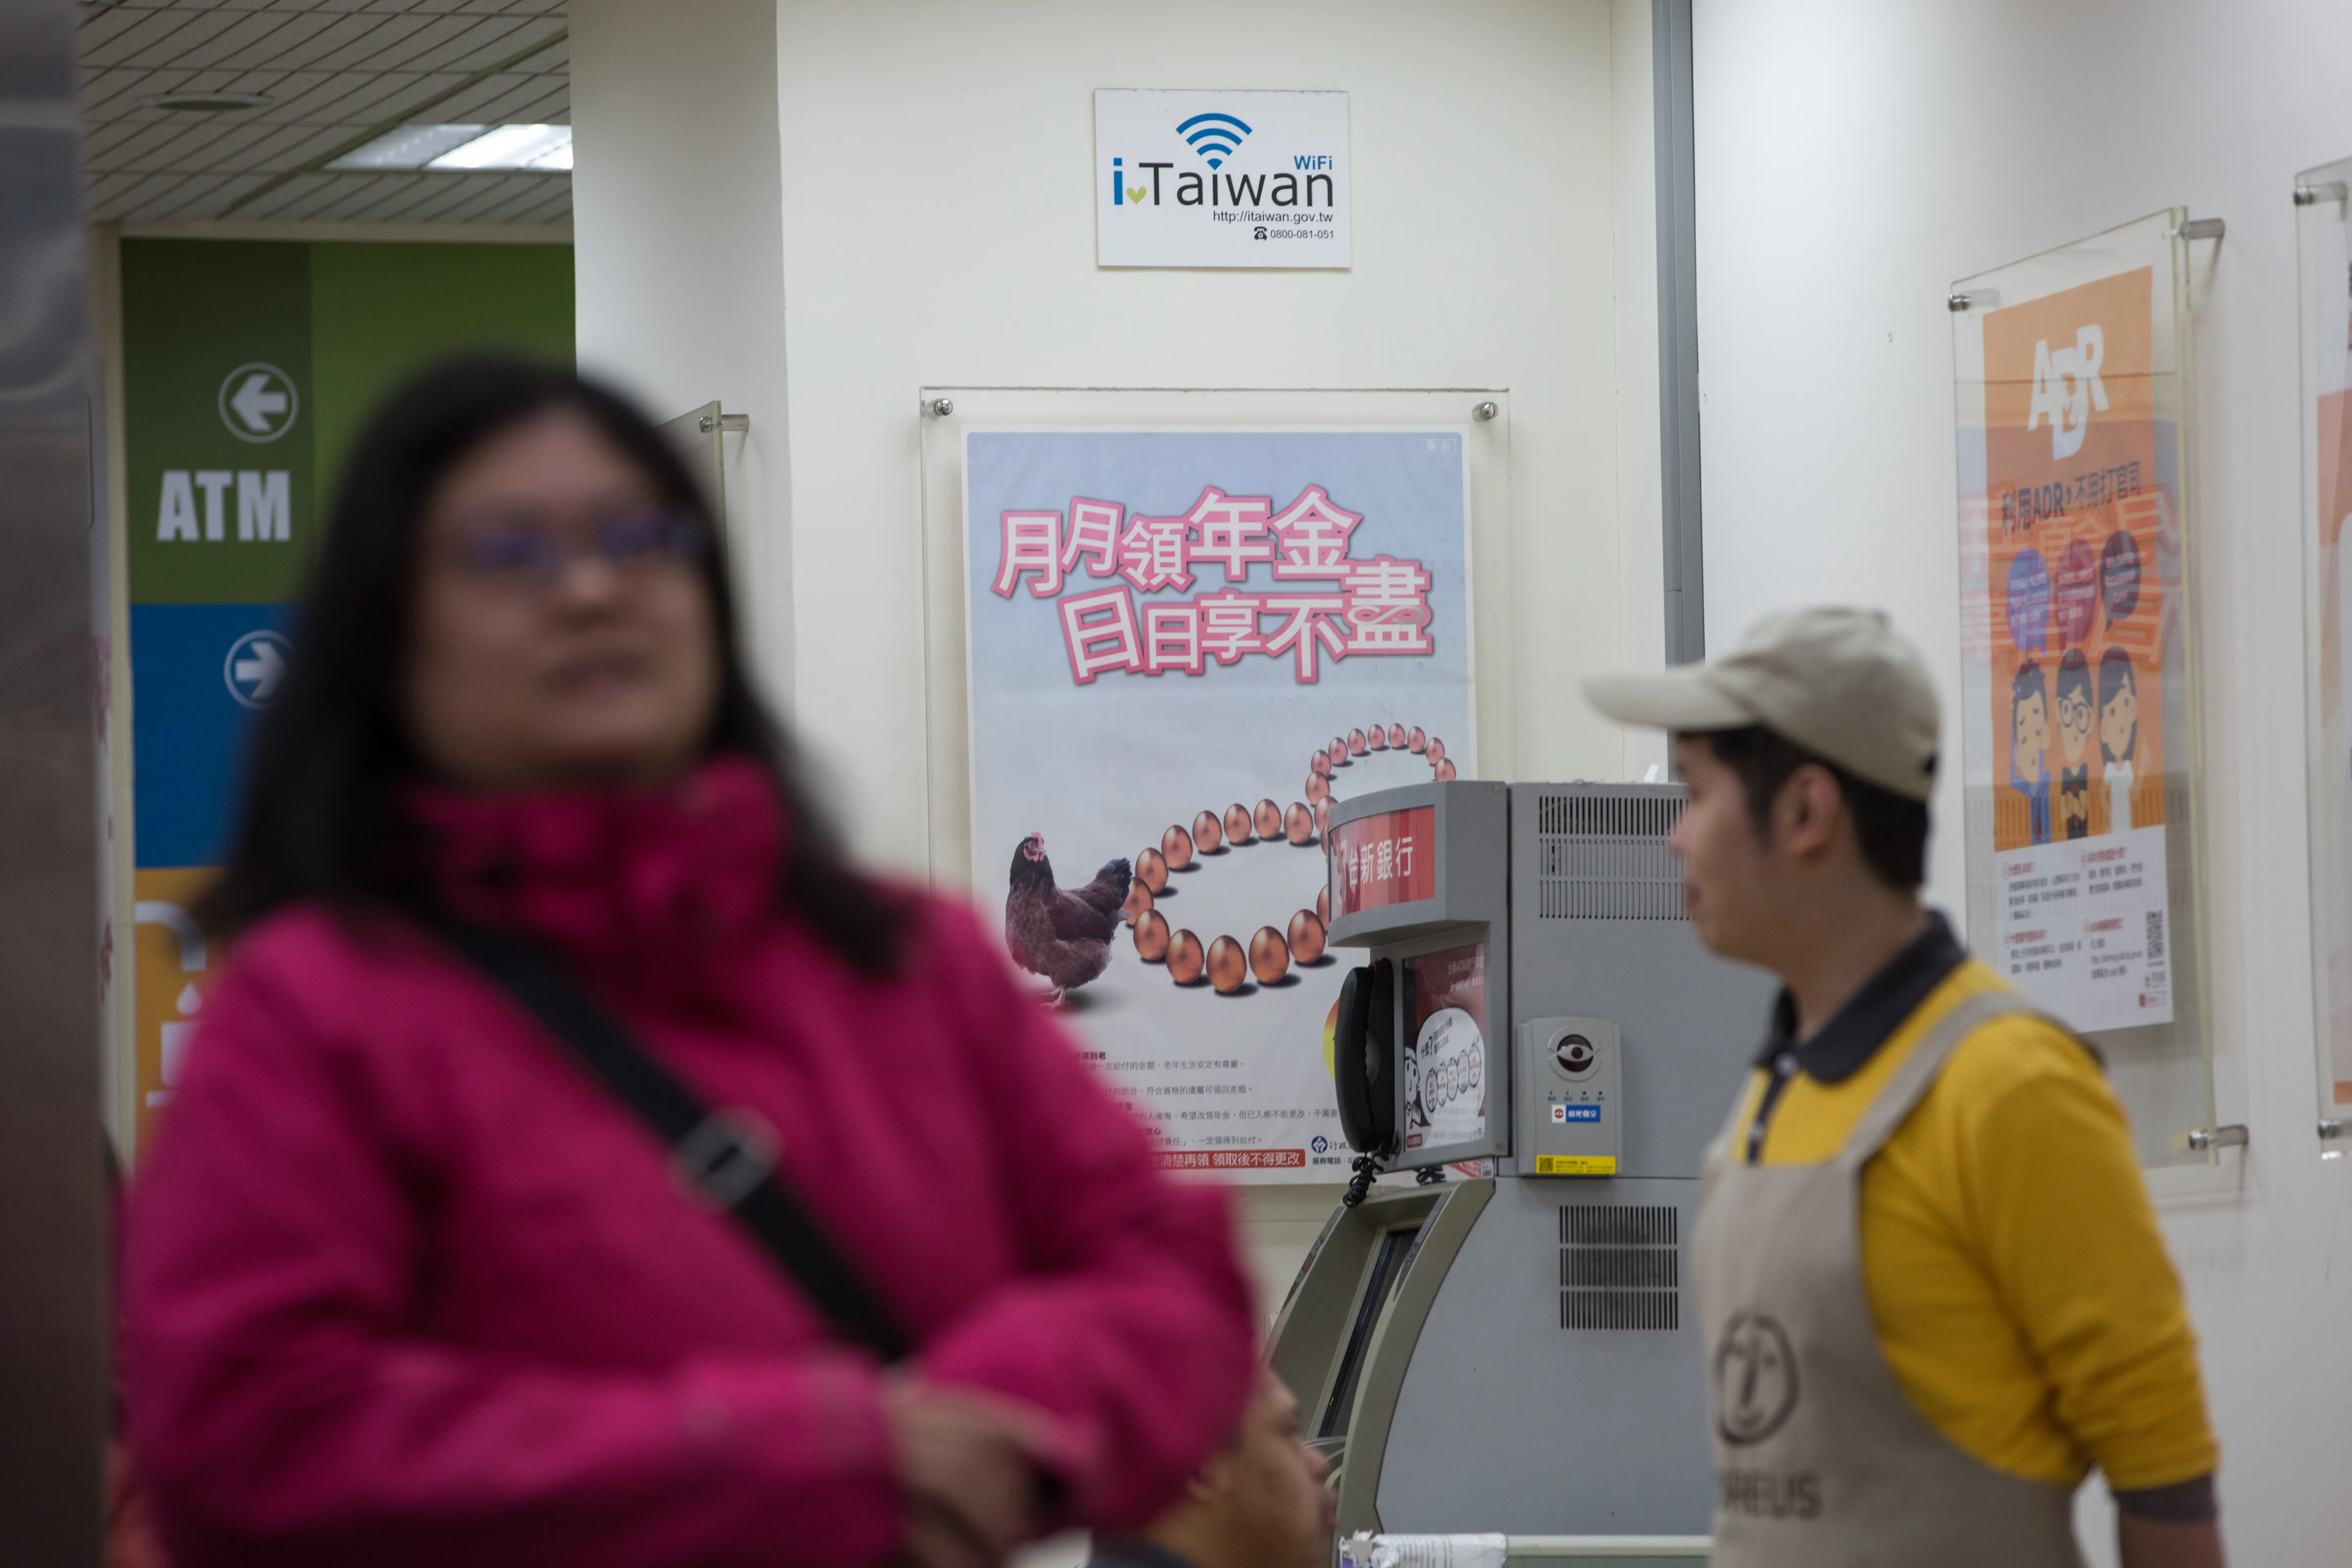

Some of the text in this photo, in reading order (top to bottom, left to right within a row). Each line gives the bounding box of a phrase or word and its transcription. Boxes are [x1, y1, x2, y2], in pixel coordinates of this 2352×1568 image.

[1294, 155, 1333, 170] WiFi
[1213, 210, 1333, 225] http://itaiwan.gov.tw
[1270, 229, 1334, 239] 0800-081-051
[2027, 323, 2109, 461] ADR
[156, 470, 291, 541] ATM
[993, 486, 1362, 596] 月月領年金
[1060, 557, 1430, 683] 日日享不盡
[1349, 836, 1414, 887] 台新銀行
[1130, 1108, 1340, 1121] 付的人後悔，希望改領年金，但已入帳不能更改，千萬要
[1568, 1109, 1597, 1118] 新光保全
[1330, 1140, 1351, 1151] 行政
[1212, 1152, 1300, 1167] 領取後不得更改
